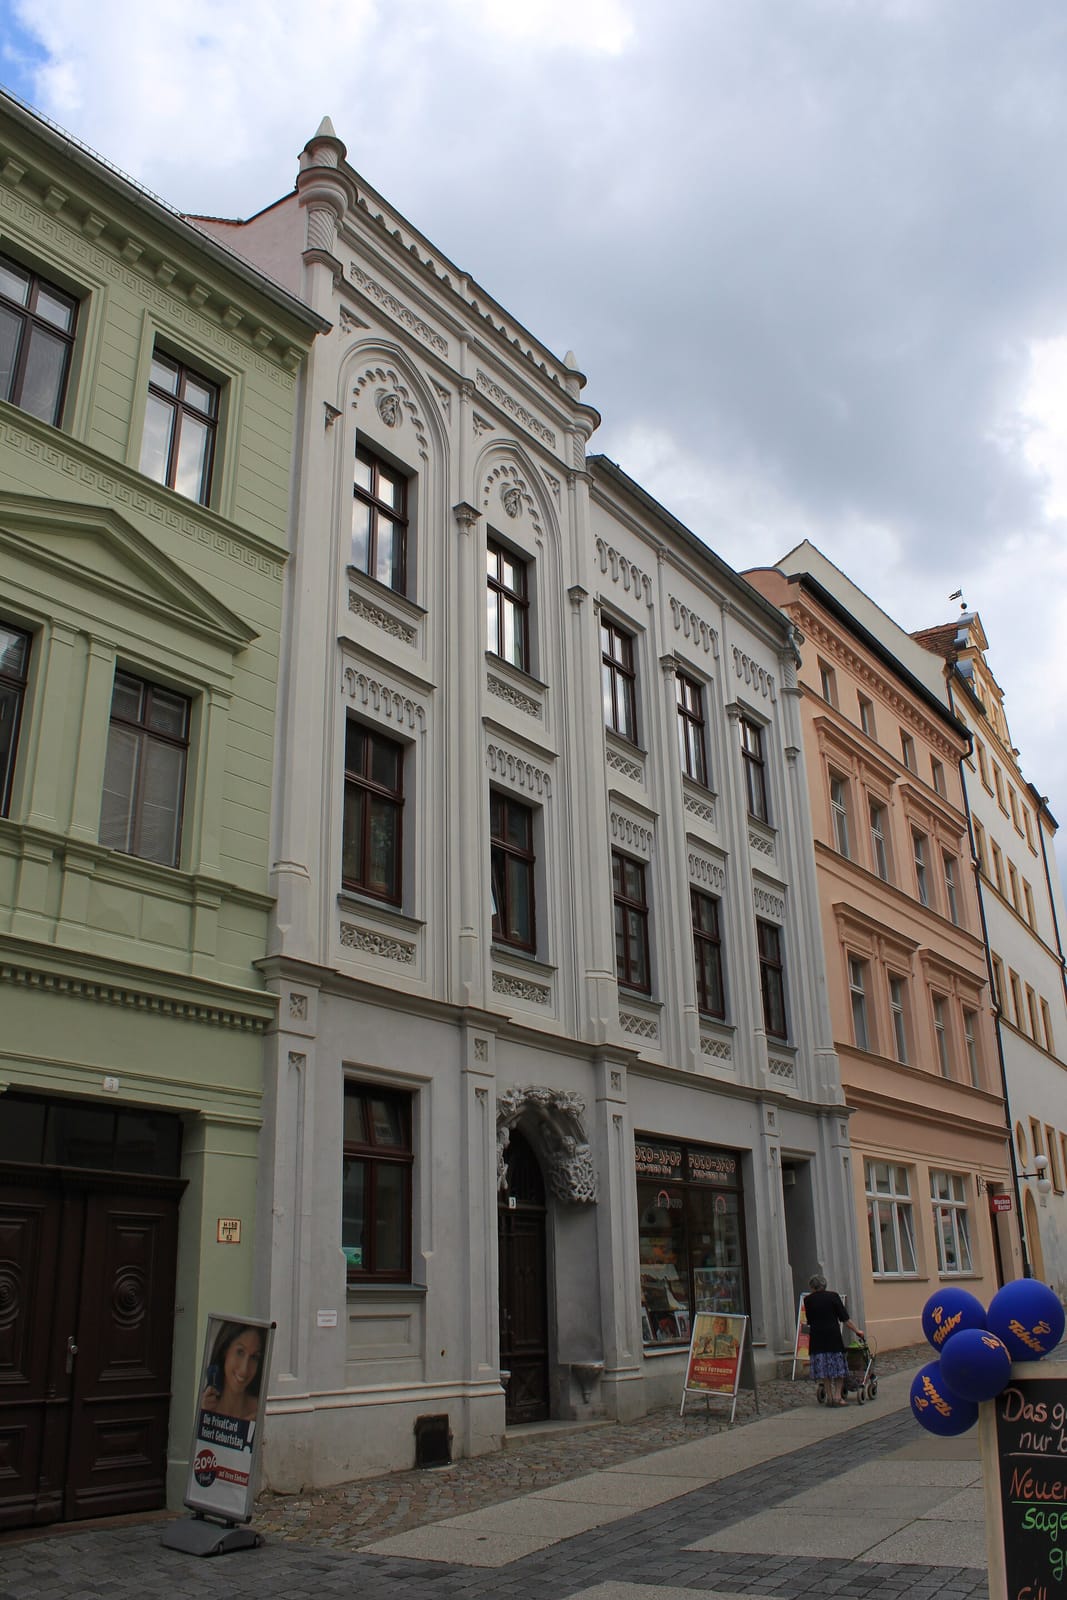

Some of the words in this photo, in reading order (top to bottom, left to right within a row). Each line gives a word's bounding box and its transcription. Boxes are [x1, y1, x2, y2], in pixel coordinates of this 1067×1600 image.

[635, 1145, 682, 1166] OTO-SHOP
[933, 1310, 963, 1344] Tchibo
[1008, 1319, 1046, 1352] Tchibo
[922, 1375, 952, 1417] Tchibo
[1002, 1387, 1048, 1423] Das
[203, 1413, 211, 1425] Die
[211, 1416, 239, 1433] PrivatCard
[202, 1426, 214, 1440] feiert
[215, 1429, 244, 1449] Geburtstag
[1019, 1431, 1052, 1452] nur
[194, 1456, 217, 1470] 20%
